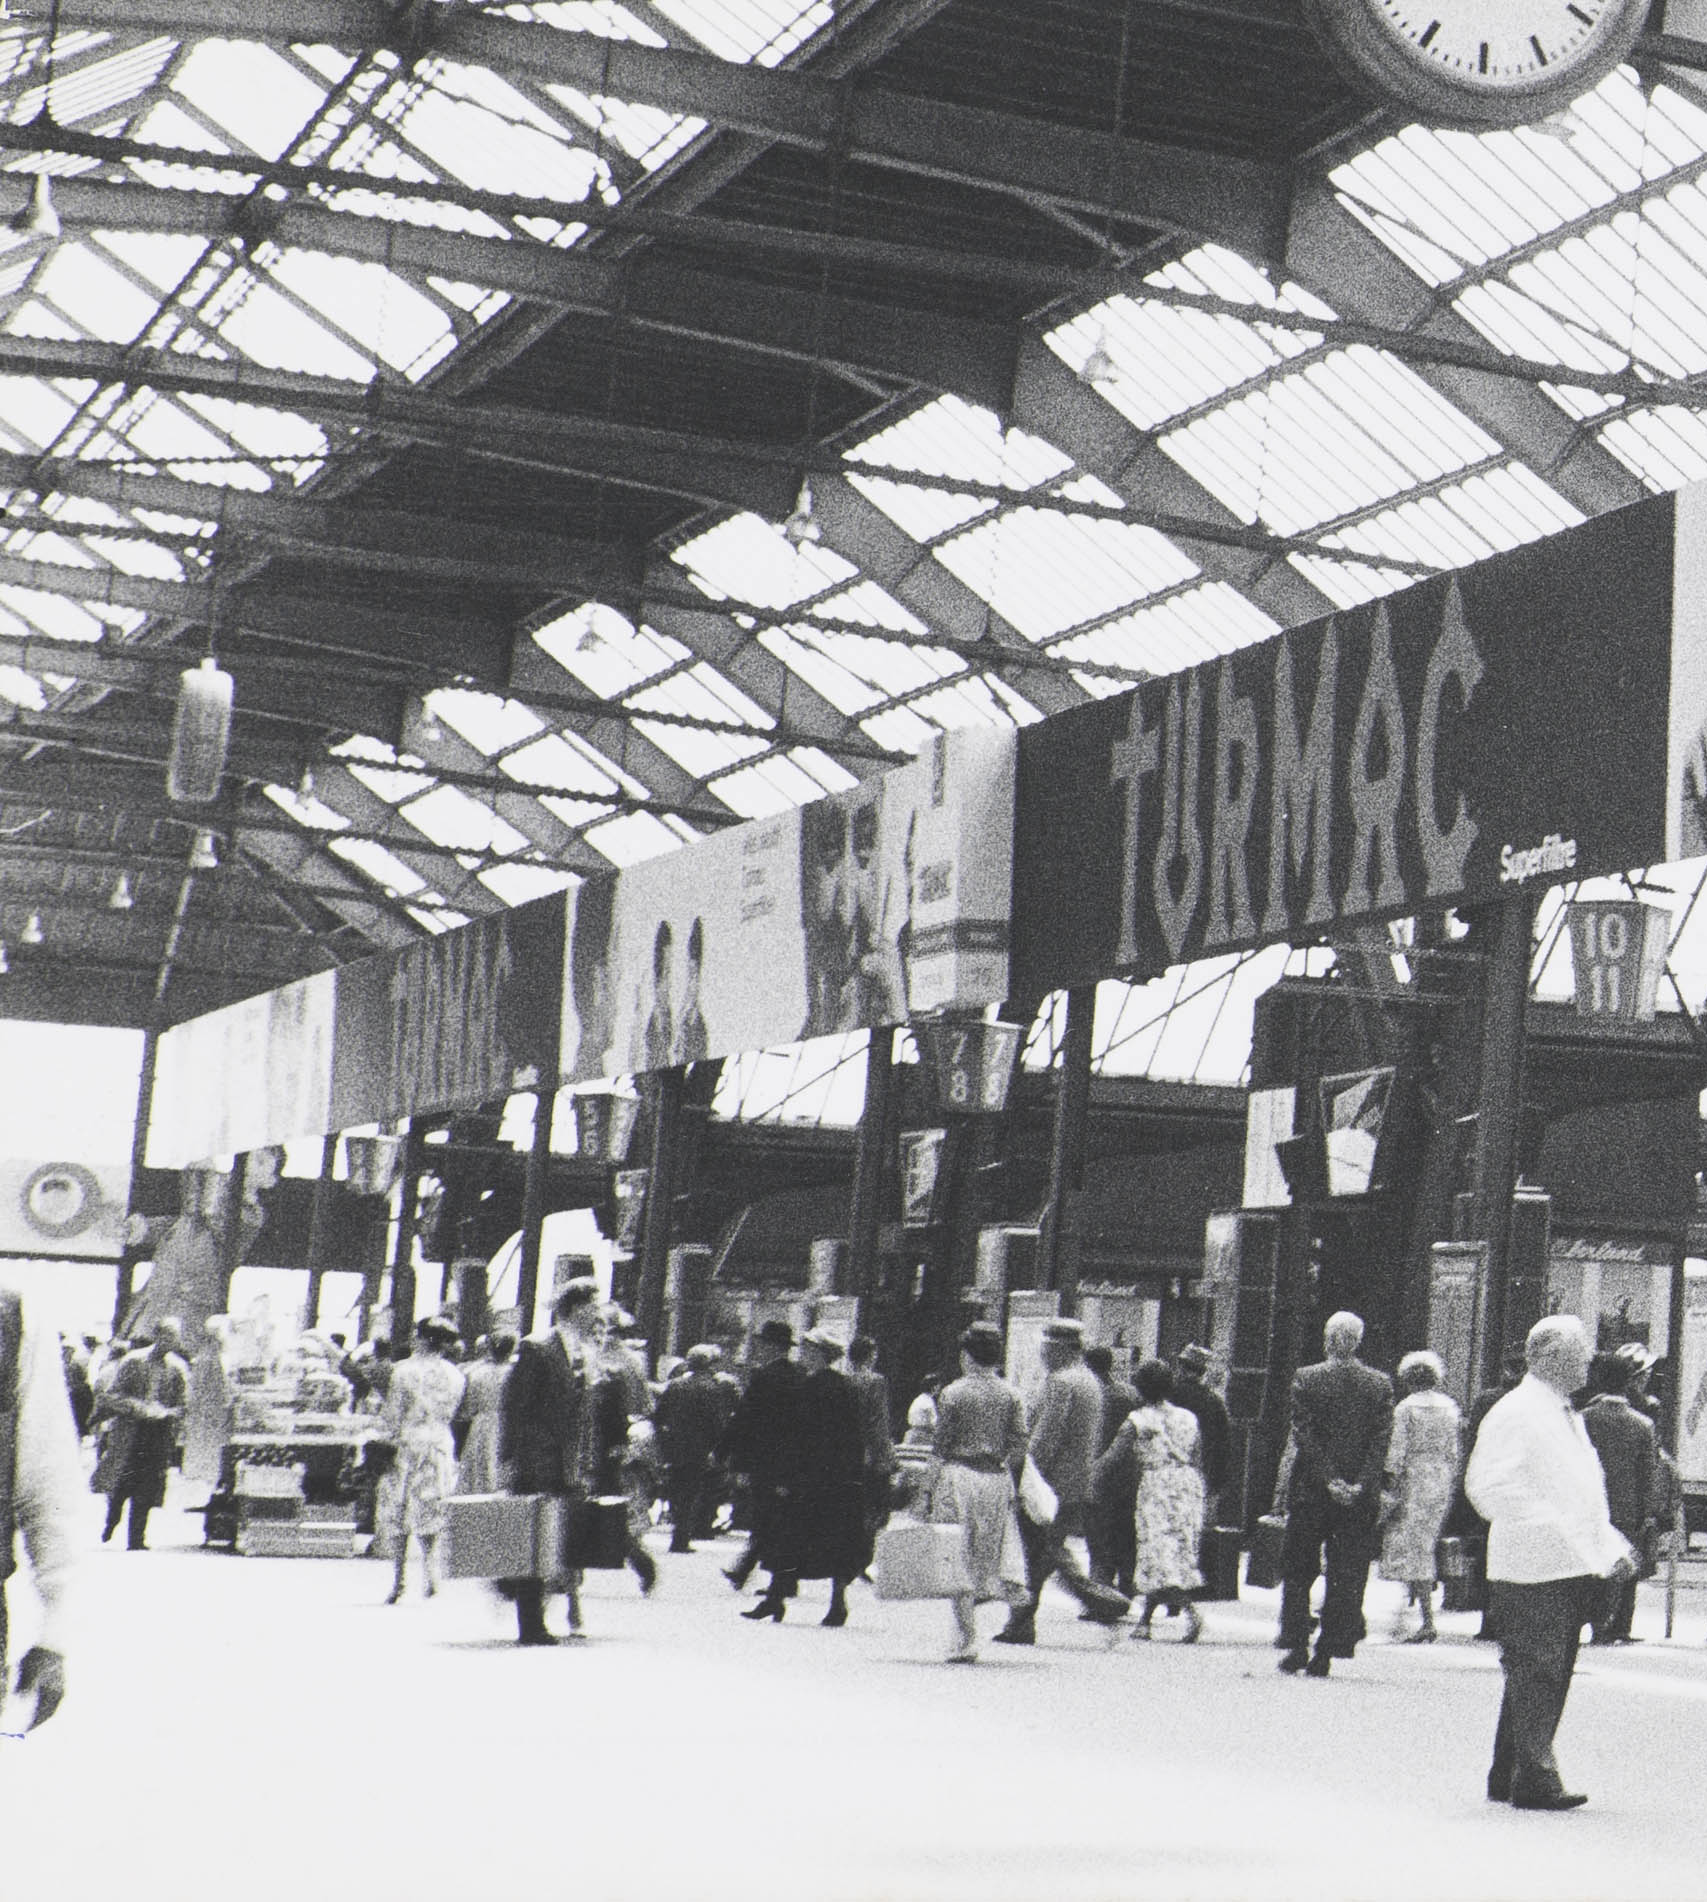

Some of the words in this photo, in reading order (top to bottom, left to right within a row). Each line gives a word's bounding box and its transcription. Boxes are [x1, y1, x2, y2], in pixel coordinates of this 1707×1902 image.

[1110, 574, 1485, 966] TURMAC
[1582, 911, 1627, 959] 10
[1589, 965, 1621, 1012] 11
[949, 1069, 968, 1103] 8
